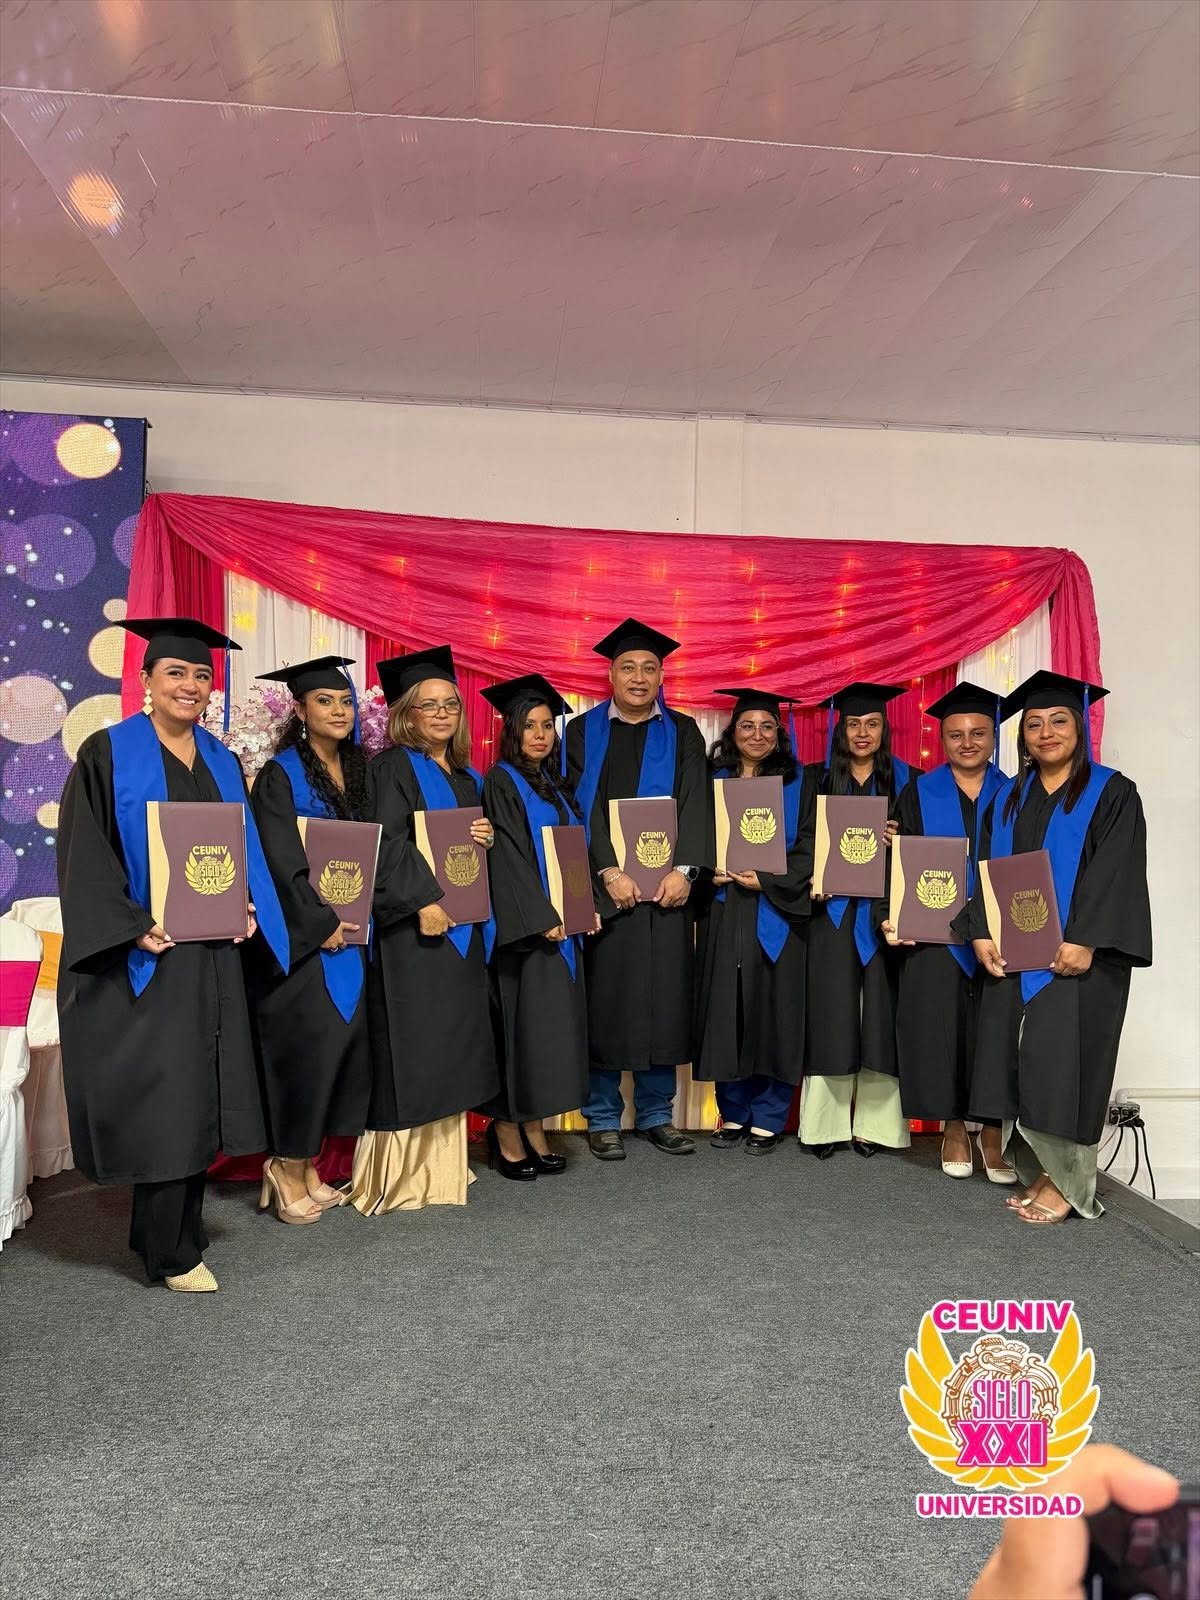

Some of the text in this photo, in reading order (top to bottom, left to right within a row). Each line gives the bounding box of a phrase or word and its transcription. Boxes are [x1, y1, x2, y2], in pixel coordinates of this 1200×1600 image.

[745, 807, 771, 816] CEUNIV
[640, 831, 666, 839] CEUNIV
[846, 827, 873, 835] CEUNIV
[192, 845, 228, 855] CEUNIV
[328, 860, 360, 870] CEUNIV
[923, 870, 952, 879] CEUNIV
[202, 877, 219, 887] XXI
[1014, 889, 1040, 900] CEUNIV
